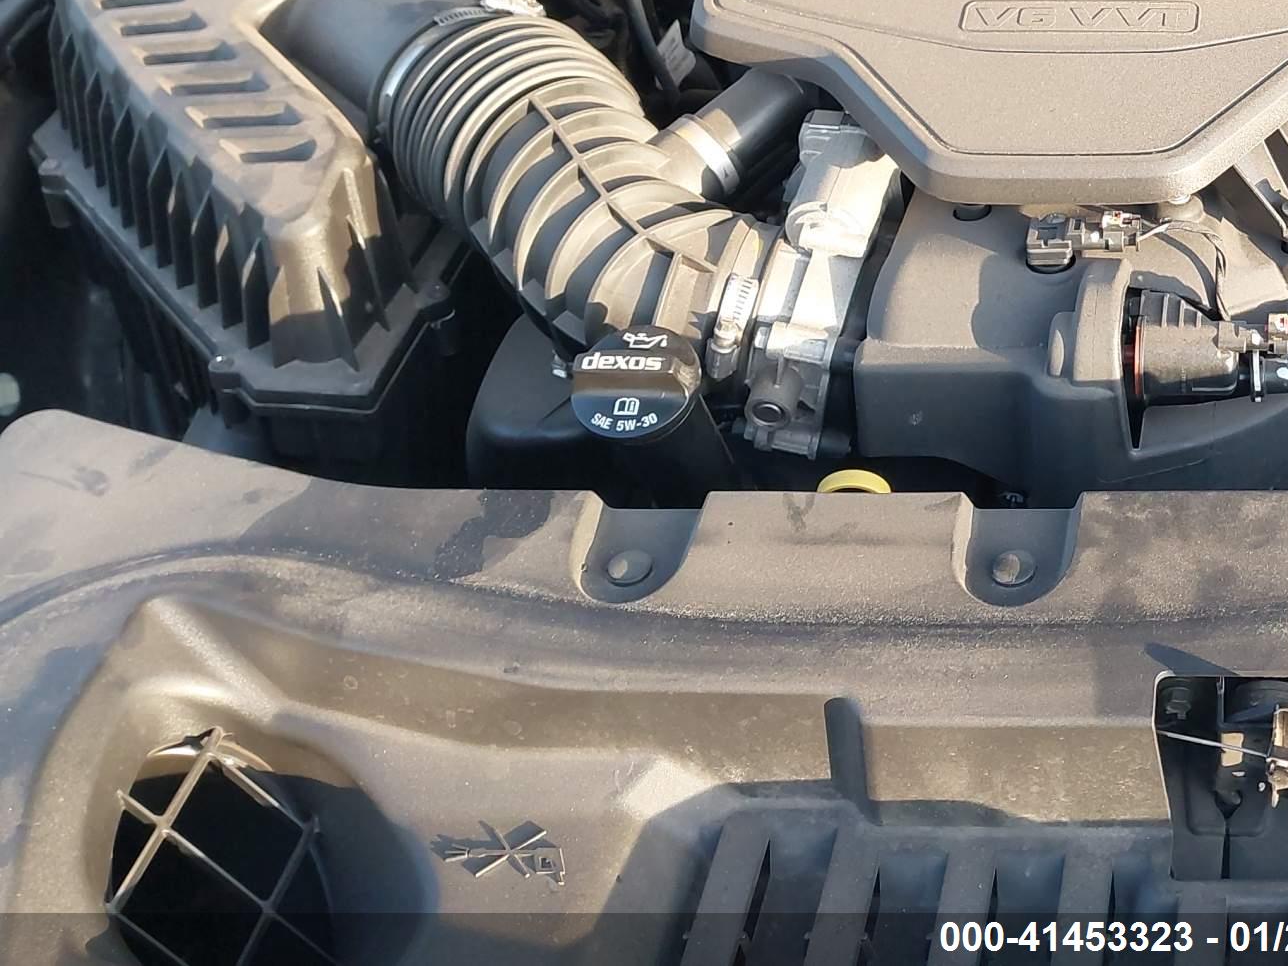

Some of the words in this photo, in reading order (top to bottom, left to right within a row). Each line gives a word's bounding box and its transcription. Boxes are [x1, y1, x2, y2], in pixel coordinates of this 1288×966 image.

[974, 6, 1057, 27] V6
[1069, 6, 1190, 27] VVT
[581, 351, 664, 371] dexos
[590, 413, 614, 431] SAE
[615, 412, 659, 432] 5W-30
